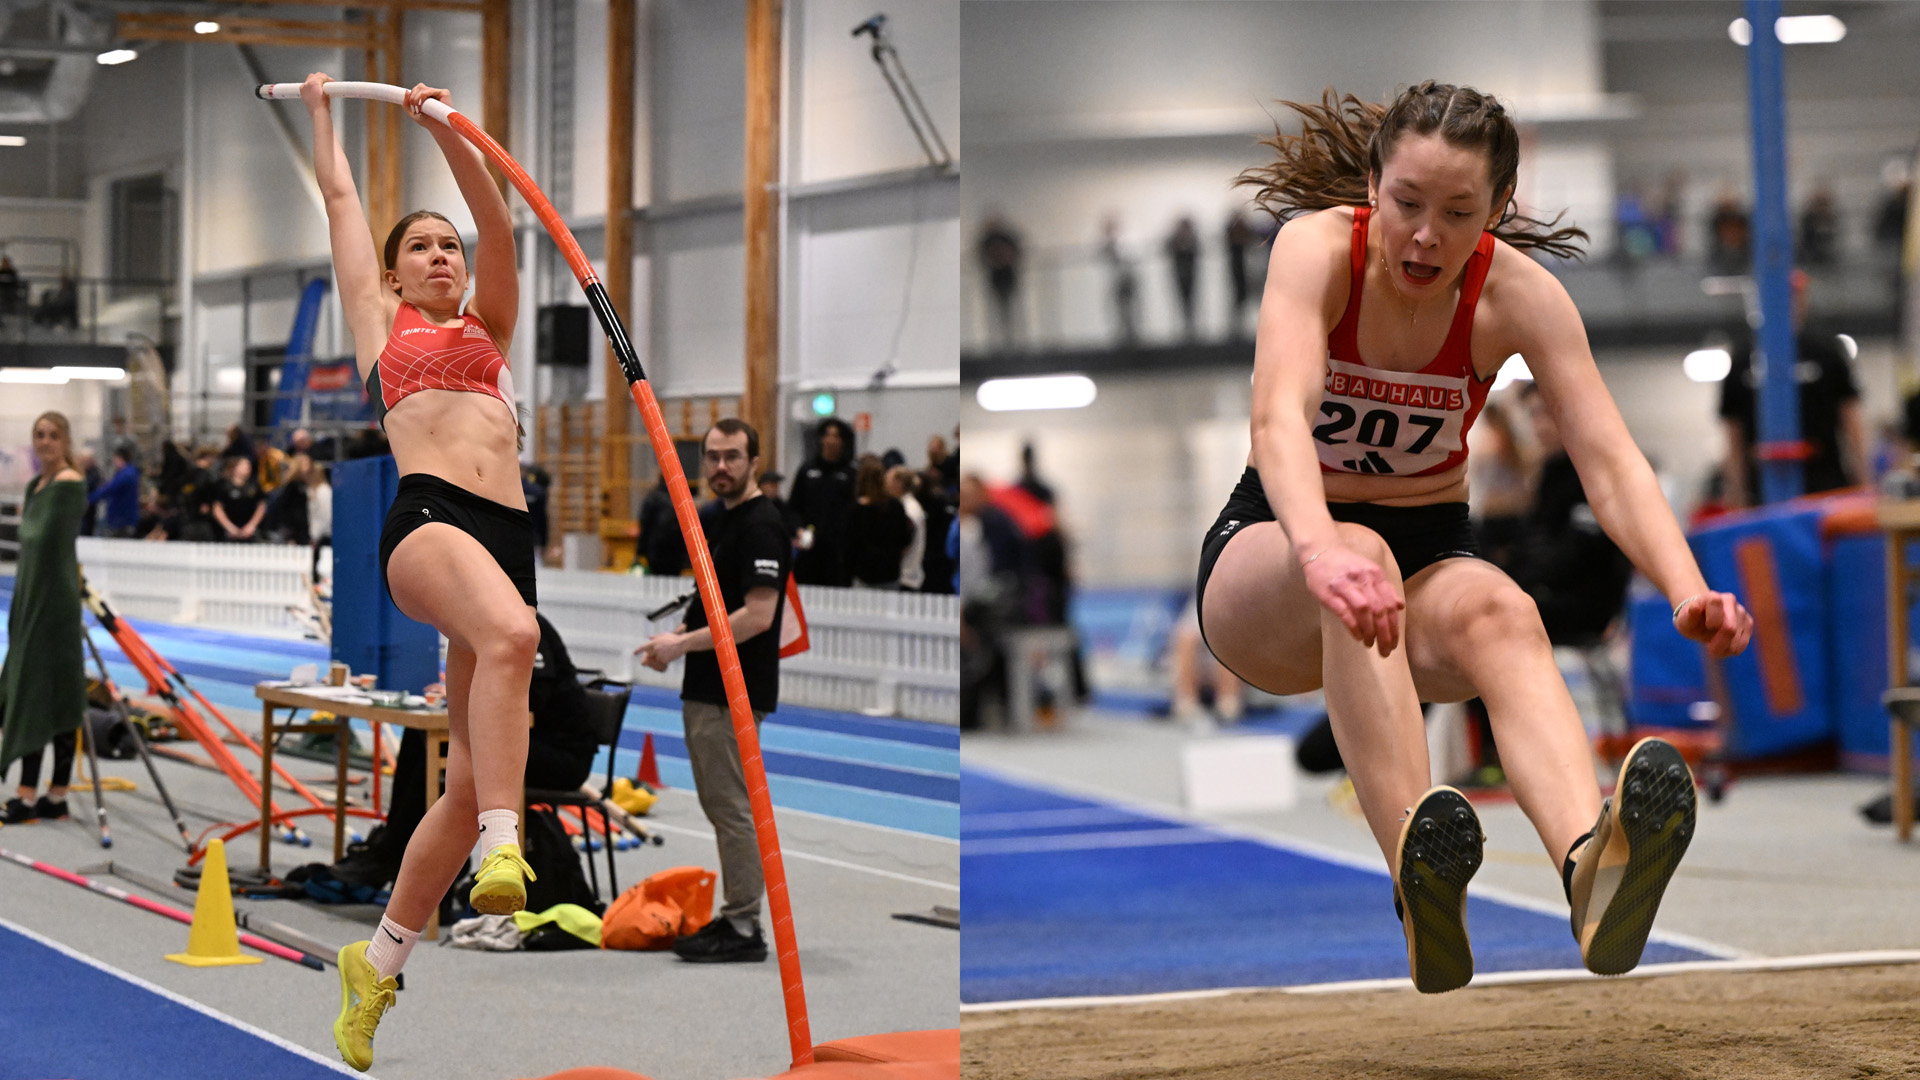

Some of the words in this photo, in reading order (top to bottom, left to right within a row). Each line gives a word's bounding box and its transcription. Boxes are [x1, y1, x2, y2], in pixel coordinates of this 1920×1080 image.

[400, 327, 438, 338] TRIMTEX
[1332, 374, 1463, 409] BAUHAUS
[1312, 401, 1445, 454] 207
